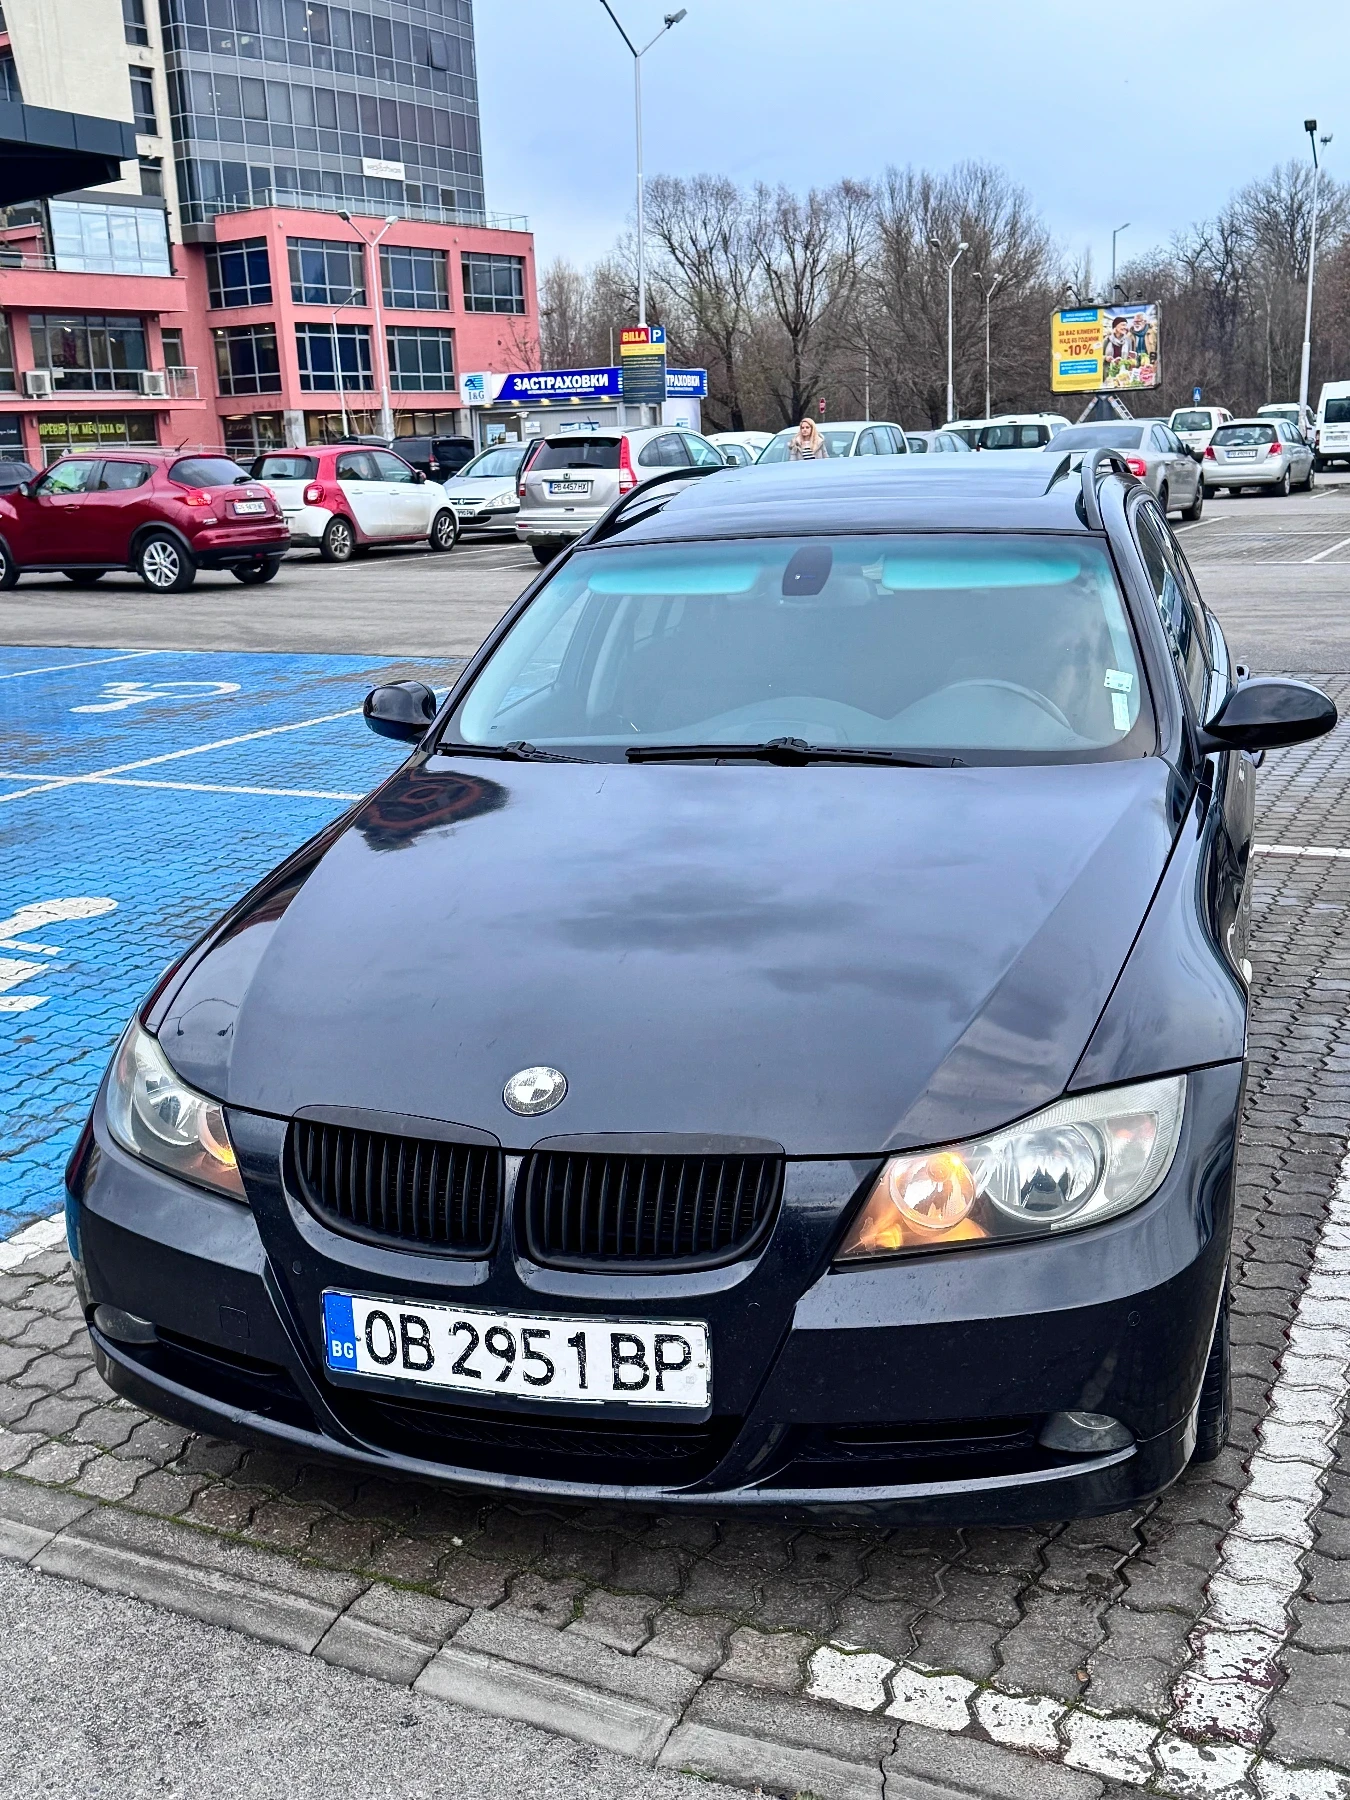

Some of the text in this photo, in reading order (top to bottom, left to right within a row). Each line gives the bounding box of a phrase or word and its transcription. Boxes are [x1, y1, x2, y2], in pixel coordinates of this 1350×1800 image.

[622, 331, 647, 342] BILLA
[652, 329, 662, 342] P
[1063, 343, 1094, 357] -10%
[513, 373, 609, 391] ЗАСТРАХОВКИ
[665, 374, 700, 387] ТРАХОВКИ
[331, 1339, 354, 1360] BG
[364, 1309, 693, 1392] OB 2951 BP
